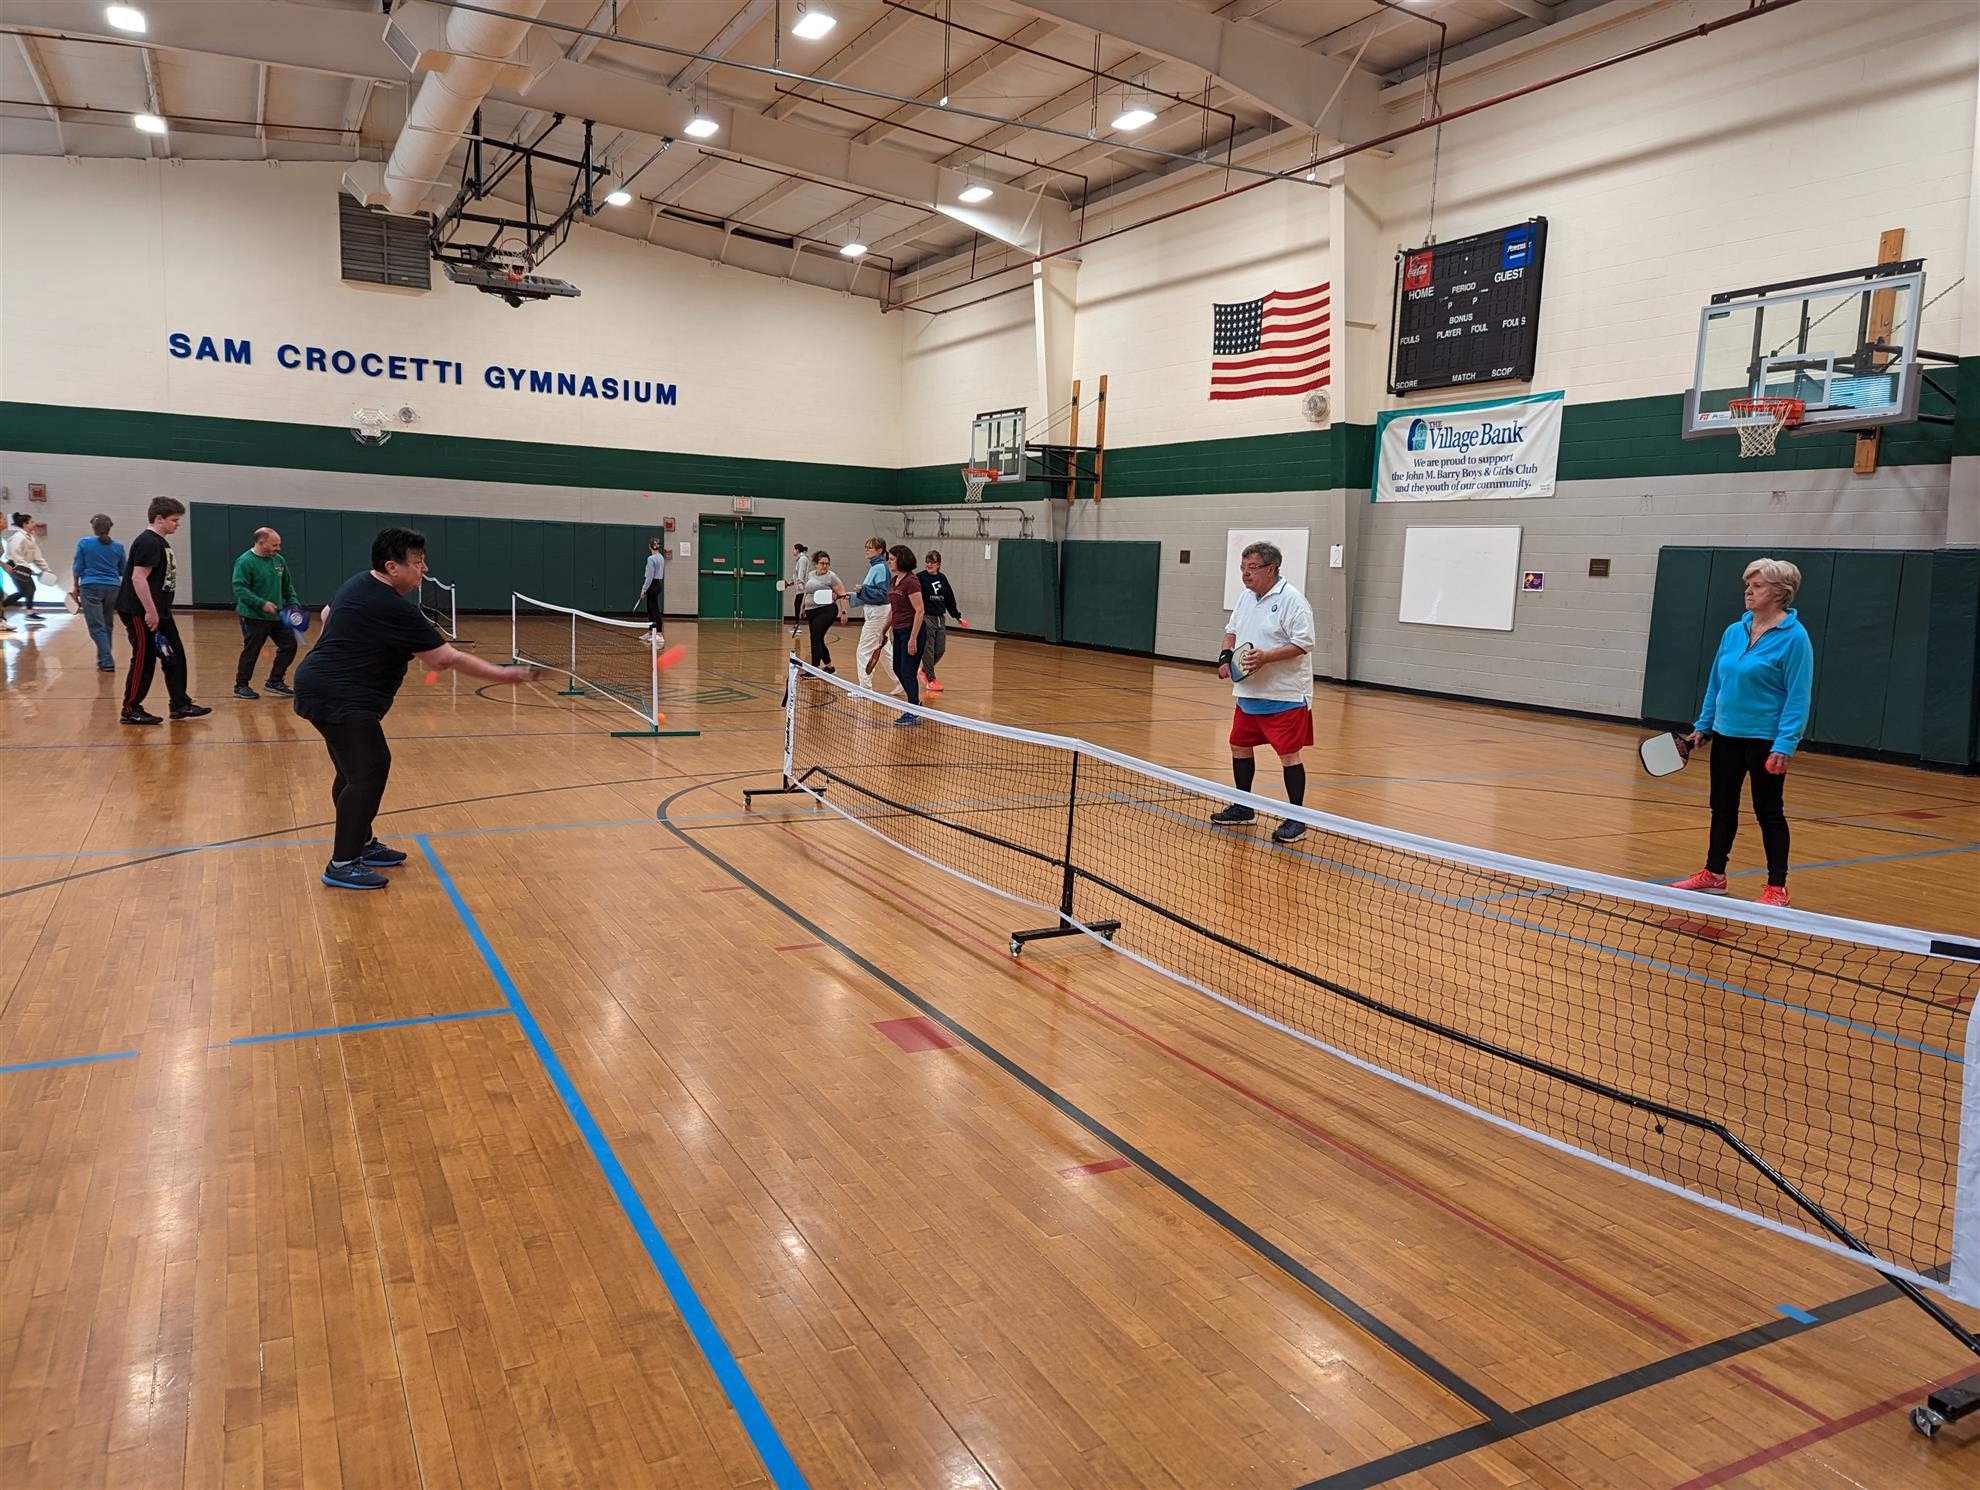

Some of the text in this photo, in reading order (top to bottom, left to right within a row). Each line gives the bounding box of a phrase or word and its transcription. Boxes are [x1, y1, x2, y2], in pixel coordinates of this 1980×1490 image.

[1494, 268, 1524, 283] GUEST
[1408, 286, 1435, 301] HOME
[1451, 282, 1477, 294] PERIOD
[1449, 313, 1473, 324] BONUS
[1436, 323, 1488, 339] PLAYER FOUL
[1400, 334, 1420, 345] FOULS
[169, 333, 678, 406] SAM CROCETTI GYMNASIUM
[1452, 372, 1476, 382] MATCH
[1396, 380, 1418, 389] SCORE
[1429, 420, 1524, 453] Village Bank
[1414, 453, 1514, 468] We are proud to support
[1391, 464, 1538, 481] the John M. Barry Boys & Girls Club
[1395, 483, 1410, 492] and
[1411, 482, 1425, 492] the
[1425, 481, 1450, 494] youth
[1450, 480, 1461, 490] of
[1460, 482, 1477, 490] our
[1476, 478, 1532, 490] community.
